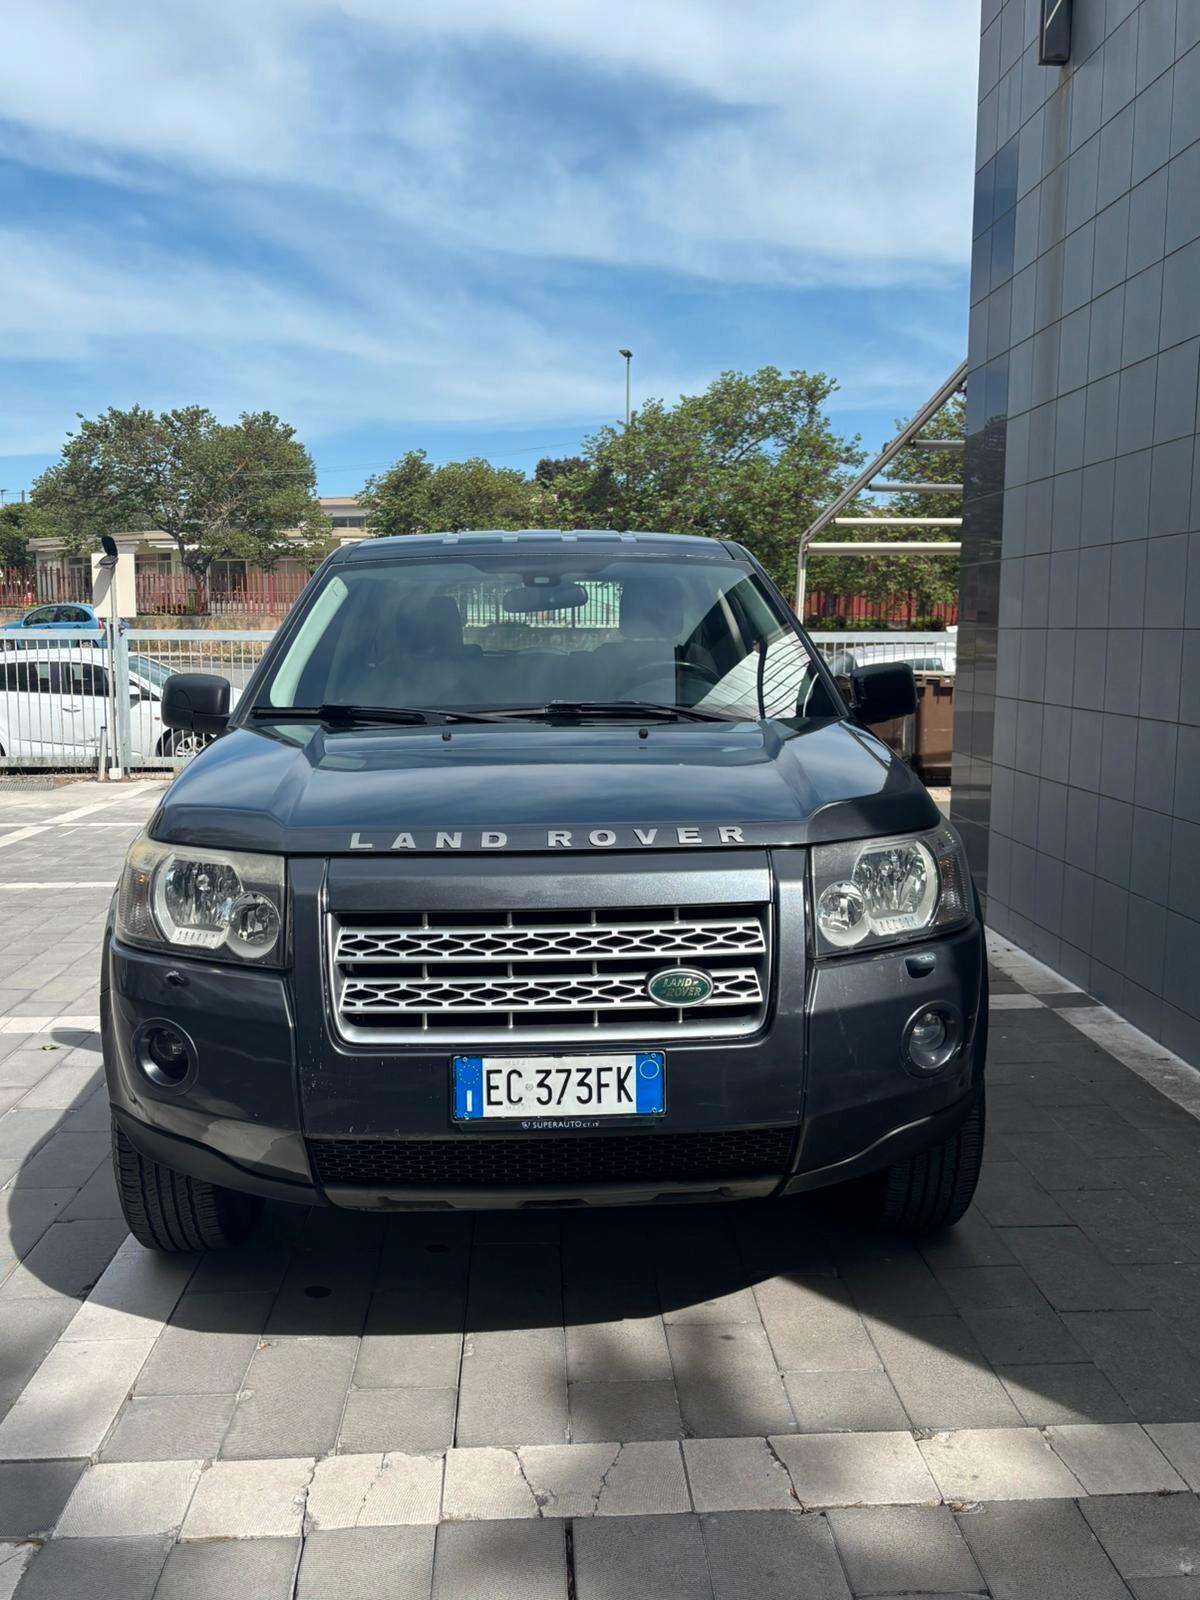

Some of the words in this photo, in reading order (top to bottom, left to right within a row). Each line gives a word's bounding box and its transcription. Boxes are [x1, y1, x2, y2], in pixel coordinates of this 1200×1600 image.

[349, 831, 508, 850] LAND
[546, 826, 745, 847] ROVER
[663, 977, 693, 988] LAND
[665, 986, 702, 997] ROVER
